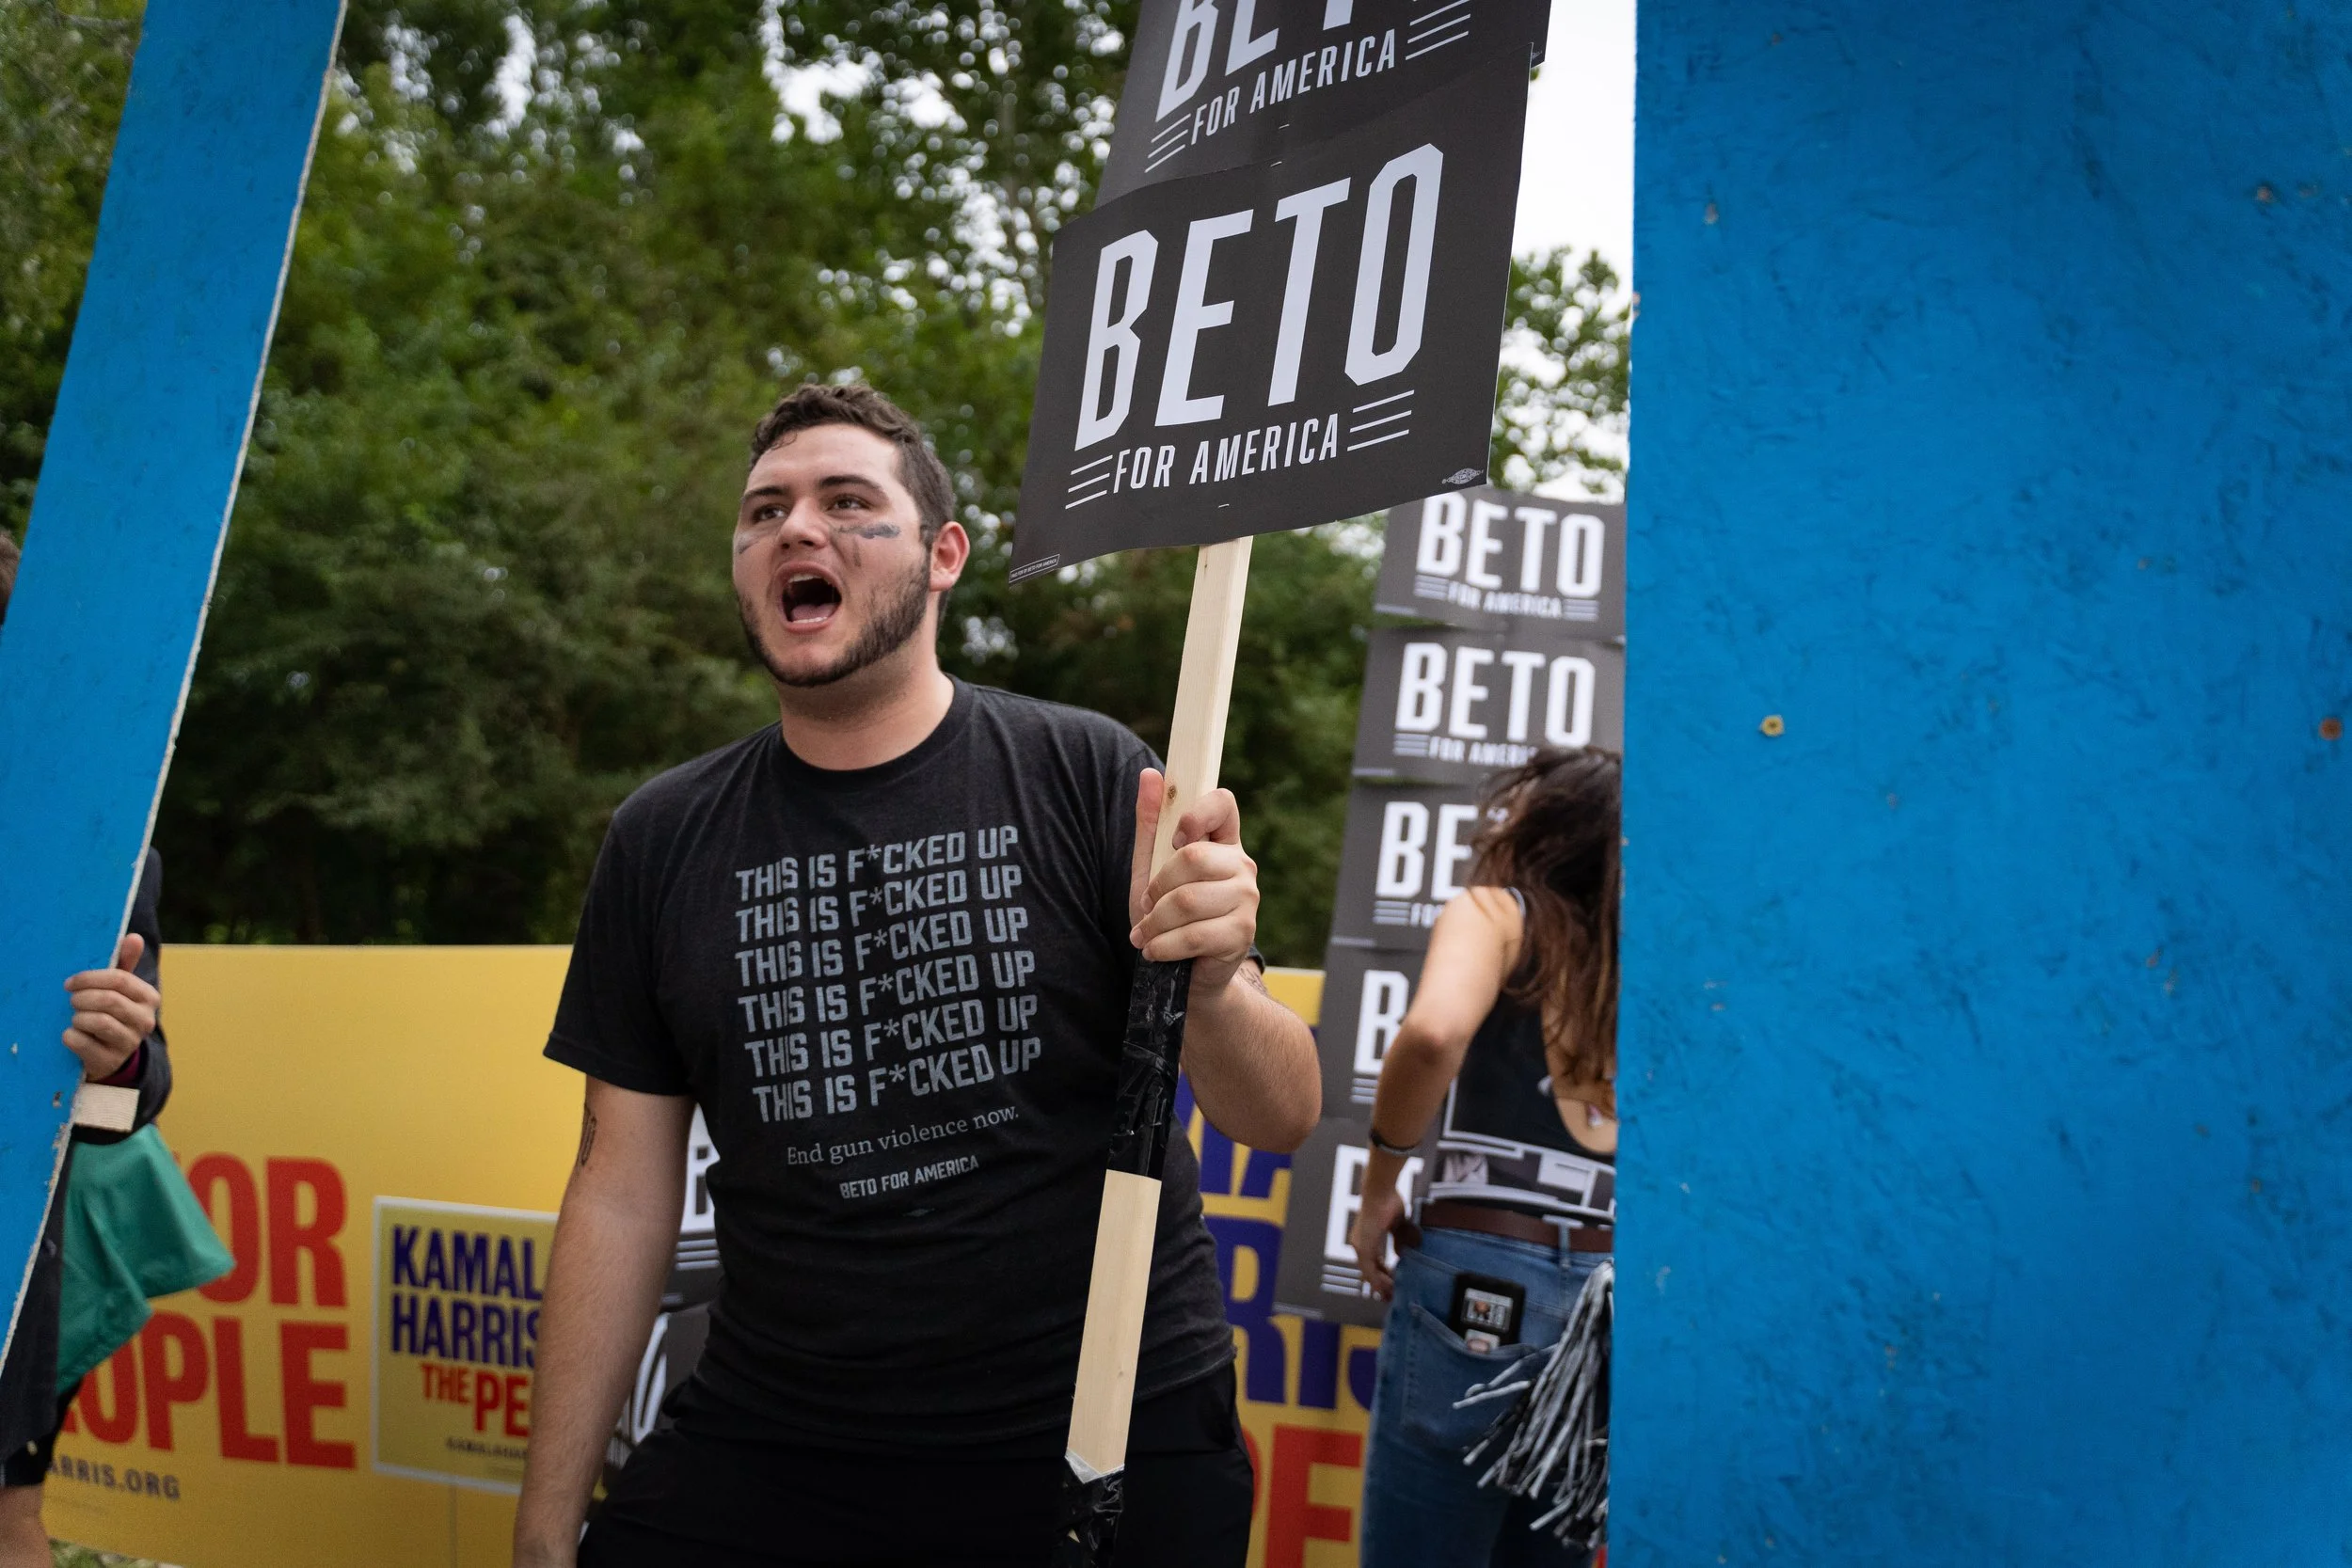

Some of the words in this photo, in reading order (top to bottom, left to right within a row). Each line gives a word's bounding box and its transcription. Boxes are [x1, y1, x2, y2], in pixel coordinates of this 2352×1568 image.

[1191, 86, 1240, 145] FOR
[1249, 28, 1395, 114] AMERICA
[1074, 142, 1444, 451] BETO
[1113, 444, 1175, 493] FOR
[1188, 414, 1339, 484] AMERICA
[1416, 491, 1605, 597] BETO
[1447, 580, 1481, 610] FOR
[1395, 642, 1595, 748] BETO
[1427, 736, 1465, 763] FOR
[735, 857, 798, 901] THIS
[807, 853, 836, 888] IS
[977, 825, 1018, 860] UP
[735, 898, 800, 942] THIS
[809, 895, 839, 932] IS
[979, 864, 1023, 900] UP
[735, 941, 803, 987] THIS
[812, 940, 843, 978] IS
[985, 907, 1028, 943] UP
[738, 986, 805, 1033] THIS
[816, 984, 847, 1022] IS
[992, 951, 1036, 990] UP
[744, 1031, 809, 1078] THIS
[820, 1029, 852, 1069] IS
[997, 995, 1038, 1031] UP
[753, 1079, 813, 1123] THIS
[824, 1075, 857, 1115] IS
[999, 1037, 1041, 1076] UP
[787, 1144, 824, 1165] End
[830, 1140, 874, 1166] gun
[878, 1119, 968, 1150] violence
[973, 1106, 1019, 1129] now.
[840, 1180, 877, 1199] BETO
[882, 1174, 910, 1192] FOR
[914, 1155, 979, 1184] AMERICA
[172, 1152, 348, 1308] OR
[390, 1226, 543, 1302] KAMAL
[62, 1311, 357, 1469] OPLE
[421, 1363, 470, 1405] THE
